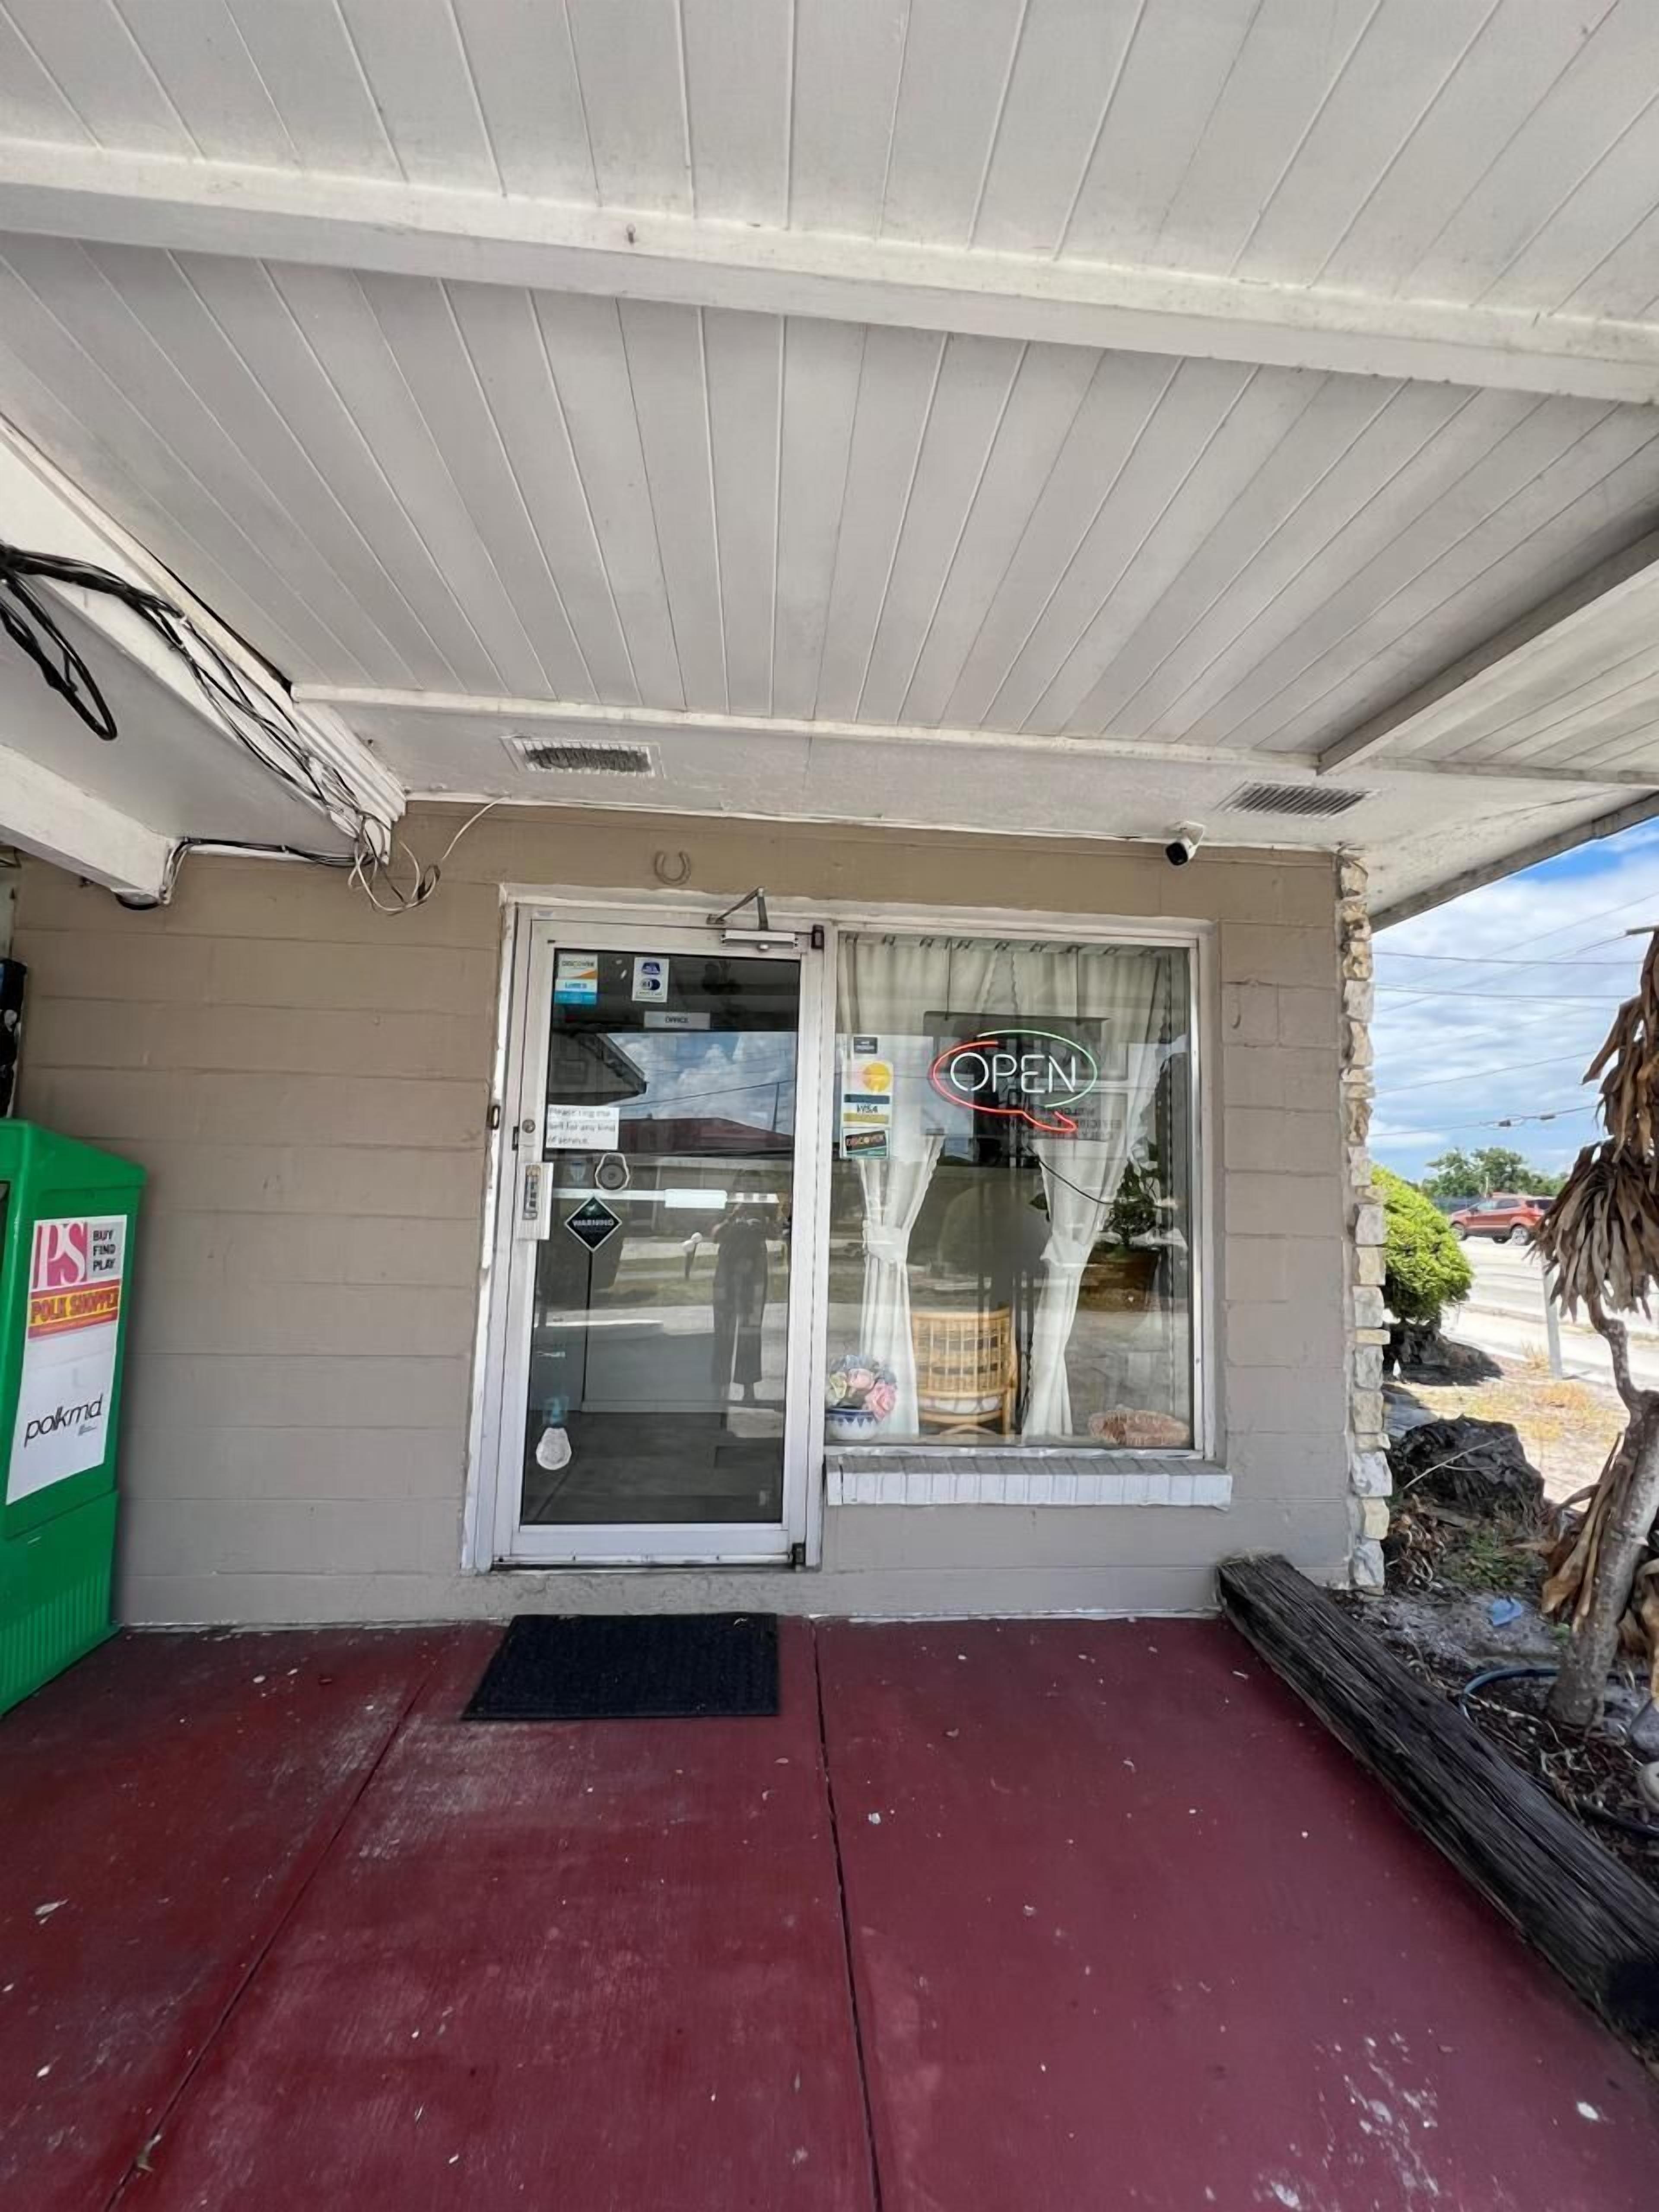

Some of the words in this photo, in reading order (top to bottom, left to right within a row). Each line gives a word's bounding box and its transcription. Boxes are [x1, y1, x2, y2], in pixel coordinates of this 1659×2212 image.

[950, 1052, 1076, 1093] OPEN
[93, 1230, 114, 1241] BUY
[93, 1244, 116, 1256] FIND
[93, 1258, 116, 1271] PLAY
